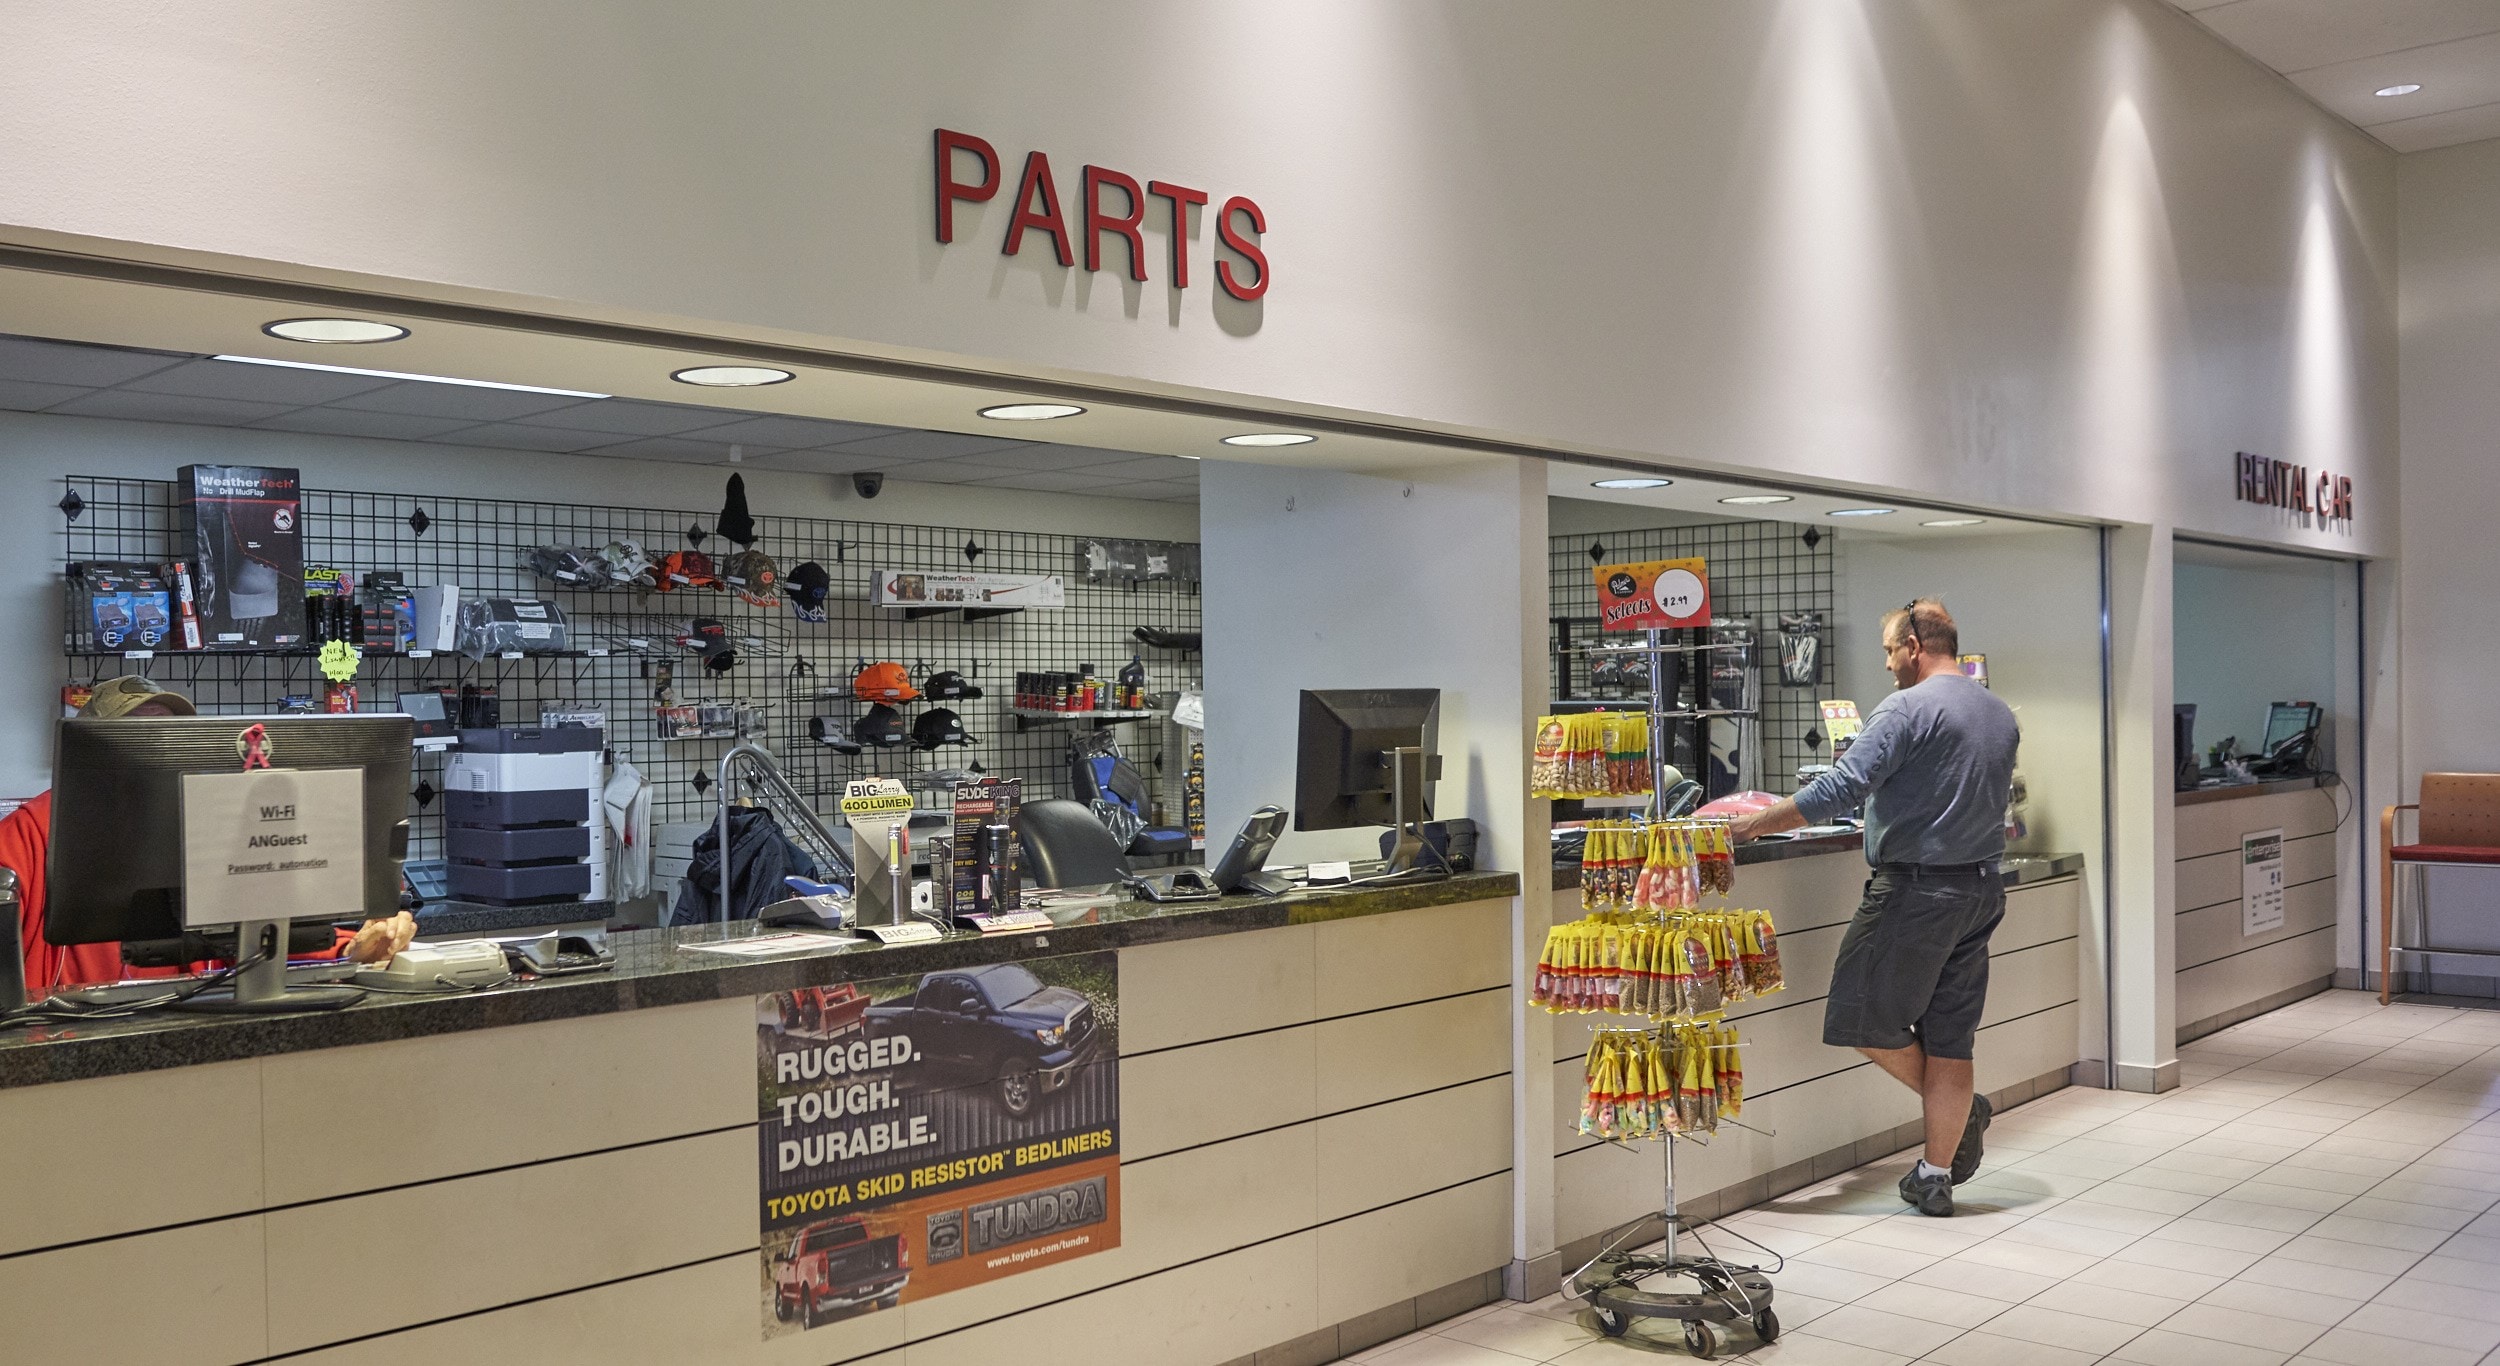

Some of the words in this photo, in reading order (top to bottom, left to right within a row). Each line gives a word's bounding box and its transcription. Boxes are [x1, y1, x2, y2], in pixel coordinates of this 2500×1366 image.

[934, 128, 1270, 300] PARTS
[203, 487, 213, 495] No
[220, 487, 234, 496] Drill
[2235, 452, 2314, 513] RENTAL
[2316, 470, 2352, 520] CAR
[1607, 598, 1652, 624] Selects
[850, 784, 877, 798] BIG
[875, 783, 900, 796] Larry
[957, 786, 989, 801] SLYDE
[989, 784, 1020, 798] KING
[260, 805, 295, 820] Wi-Fi
[844, 800, 869, 811] 400
[870, 798, 912, 810] LUMEN
[248, 833, 308, 849] ANGuest
[880, 928, 911, 939] BIG
[777, 1035, 921, 1084] RUGGED.
[777, 1080, 900, 1127] TOUGH.
[778, 1115, 938, 1172] DURABLE.
[768, 1187, 851, 1220] TOYOTA
[857, 1172, 905, 1202] SKID
[1016, 1129, 1113, 1167] BEDLINERS
[929, 1212, 960, 1225] TOYOTA
[973, 1184, 1102, 1245] TUNDRA
[987, 1235, 1090, 1269] www.toyota.com/tundra
